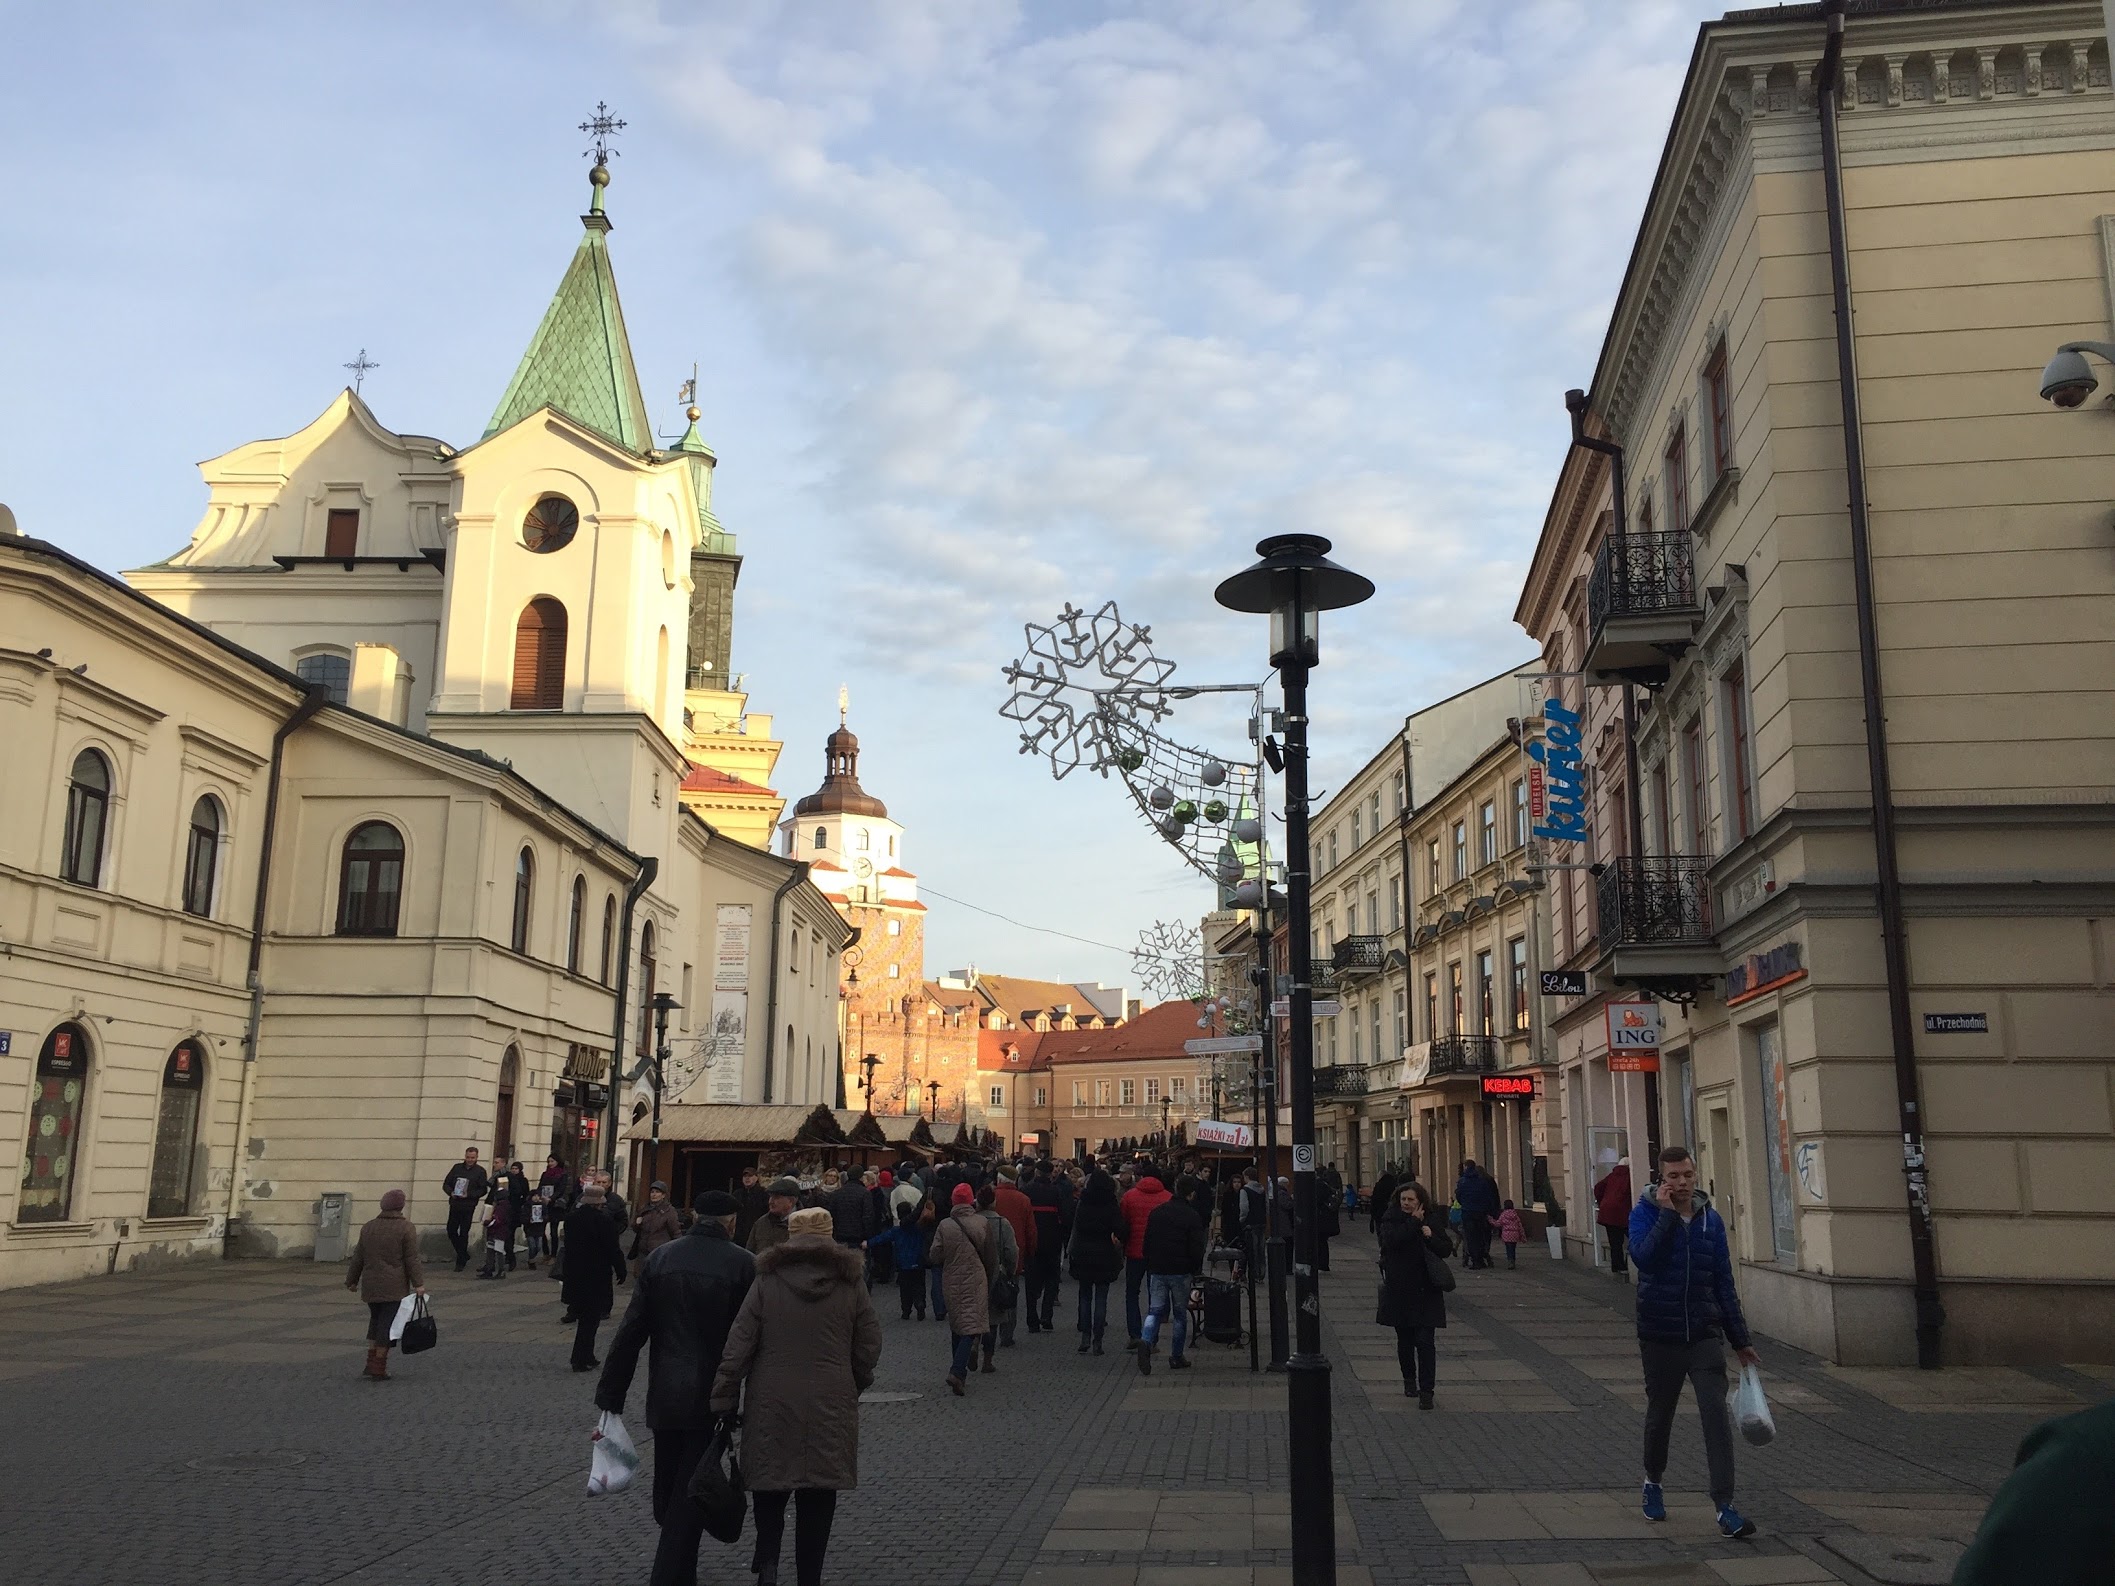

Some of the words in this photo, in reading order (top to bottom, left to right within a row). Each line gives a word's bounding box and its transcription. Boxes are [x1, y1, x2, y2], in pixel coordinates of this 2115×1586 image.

[1529, 698, 1587, 842] kurier
[1532, 769, 1542, 817] LUBELSKI
[1543, 973, 1583, 993] Lilou
[1937, 1016, 1986, 1029] Przechodnia
[1, 1040, 8, 1052] 3
[1616, 1030, 1656, 1044] ING
[570, 1044, 610, 1079] Jubiler
[1484, 1078, 1532, 1093] KEBAB
[1197, 1127, 1225, 1143] KSIĄŻKI
[1226, 1134, 1235, 1143] za
[1235, 1126, 1242, 1148] 1
[1241, 1134, 1249, 1145] zł
